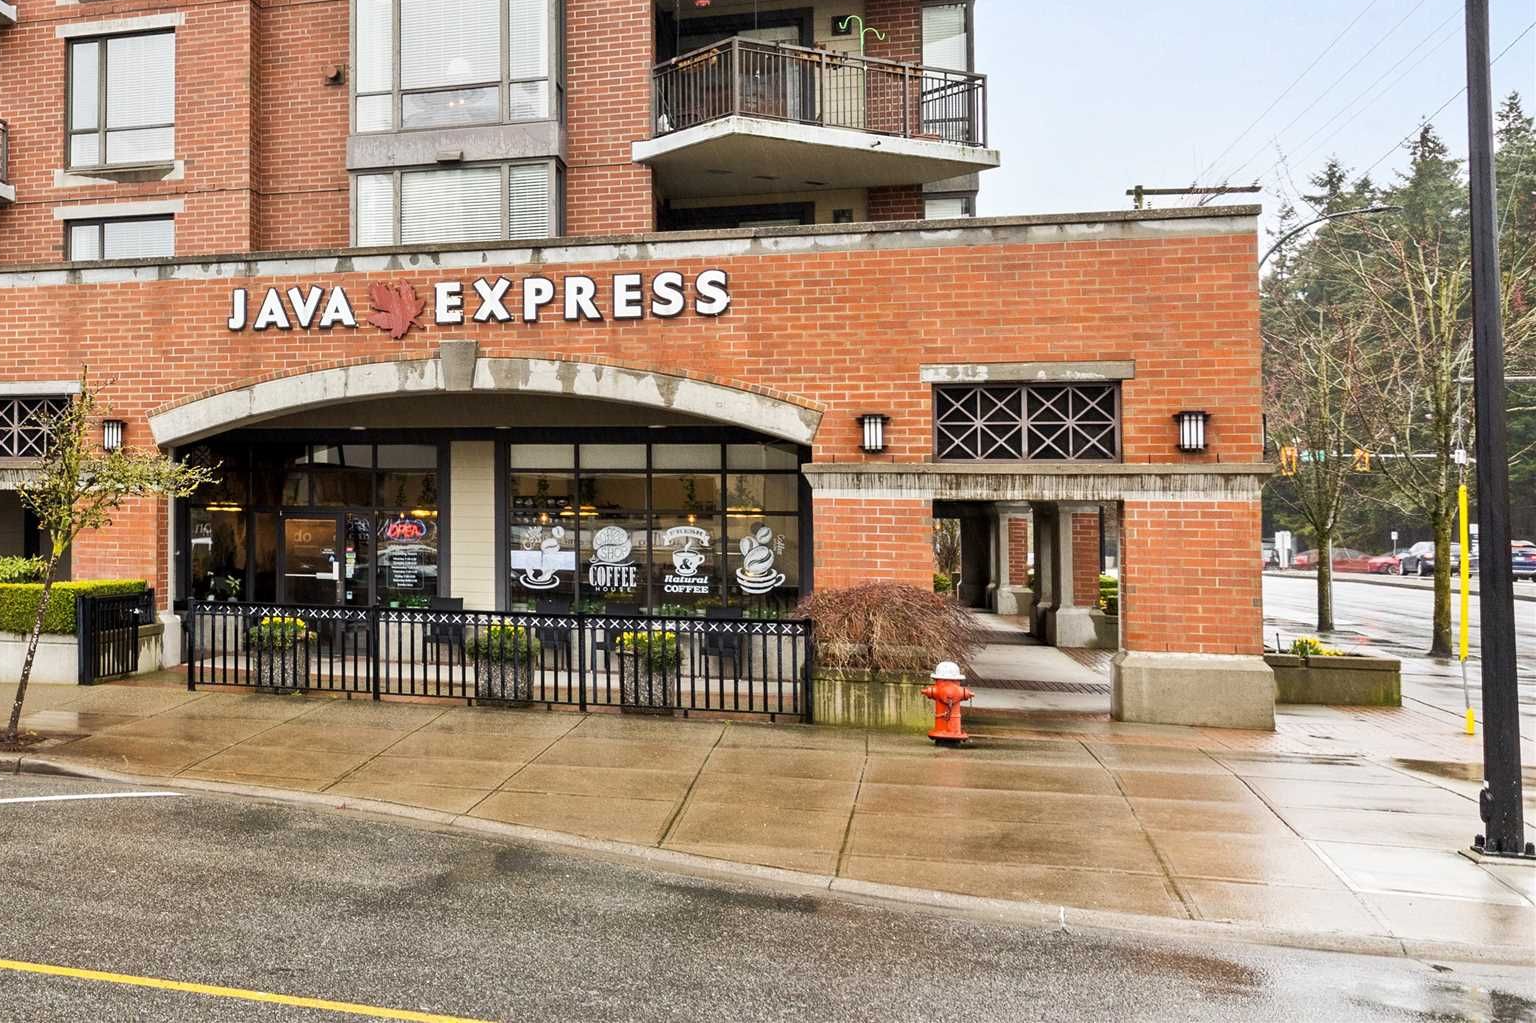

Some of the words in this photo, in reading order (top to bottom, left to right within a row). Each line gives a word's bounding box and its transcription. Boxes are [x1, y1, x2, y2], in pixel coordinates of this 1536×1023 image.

[228, 284, 358, 332] JAVA
[433, 268, 731, 325] EXPRESS
[387, 523, 421, 539] OPEN
[600, 546, 627, 560] SHOP
[680, 558, 693, 569] &
[589, 566, 637, 587] COFFEE
[664, 575, 709, 584] Natural
[664, 585, 709, 593] COFFEE
